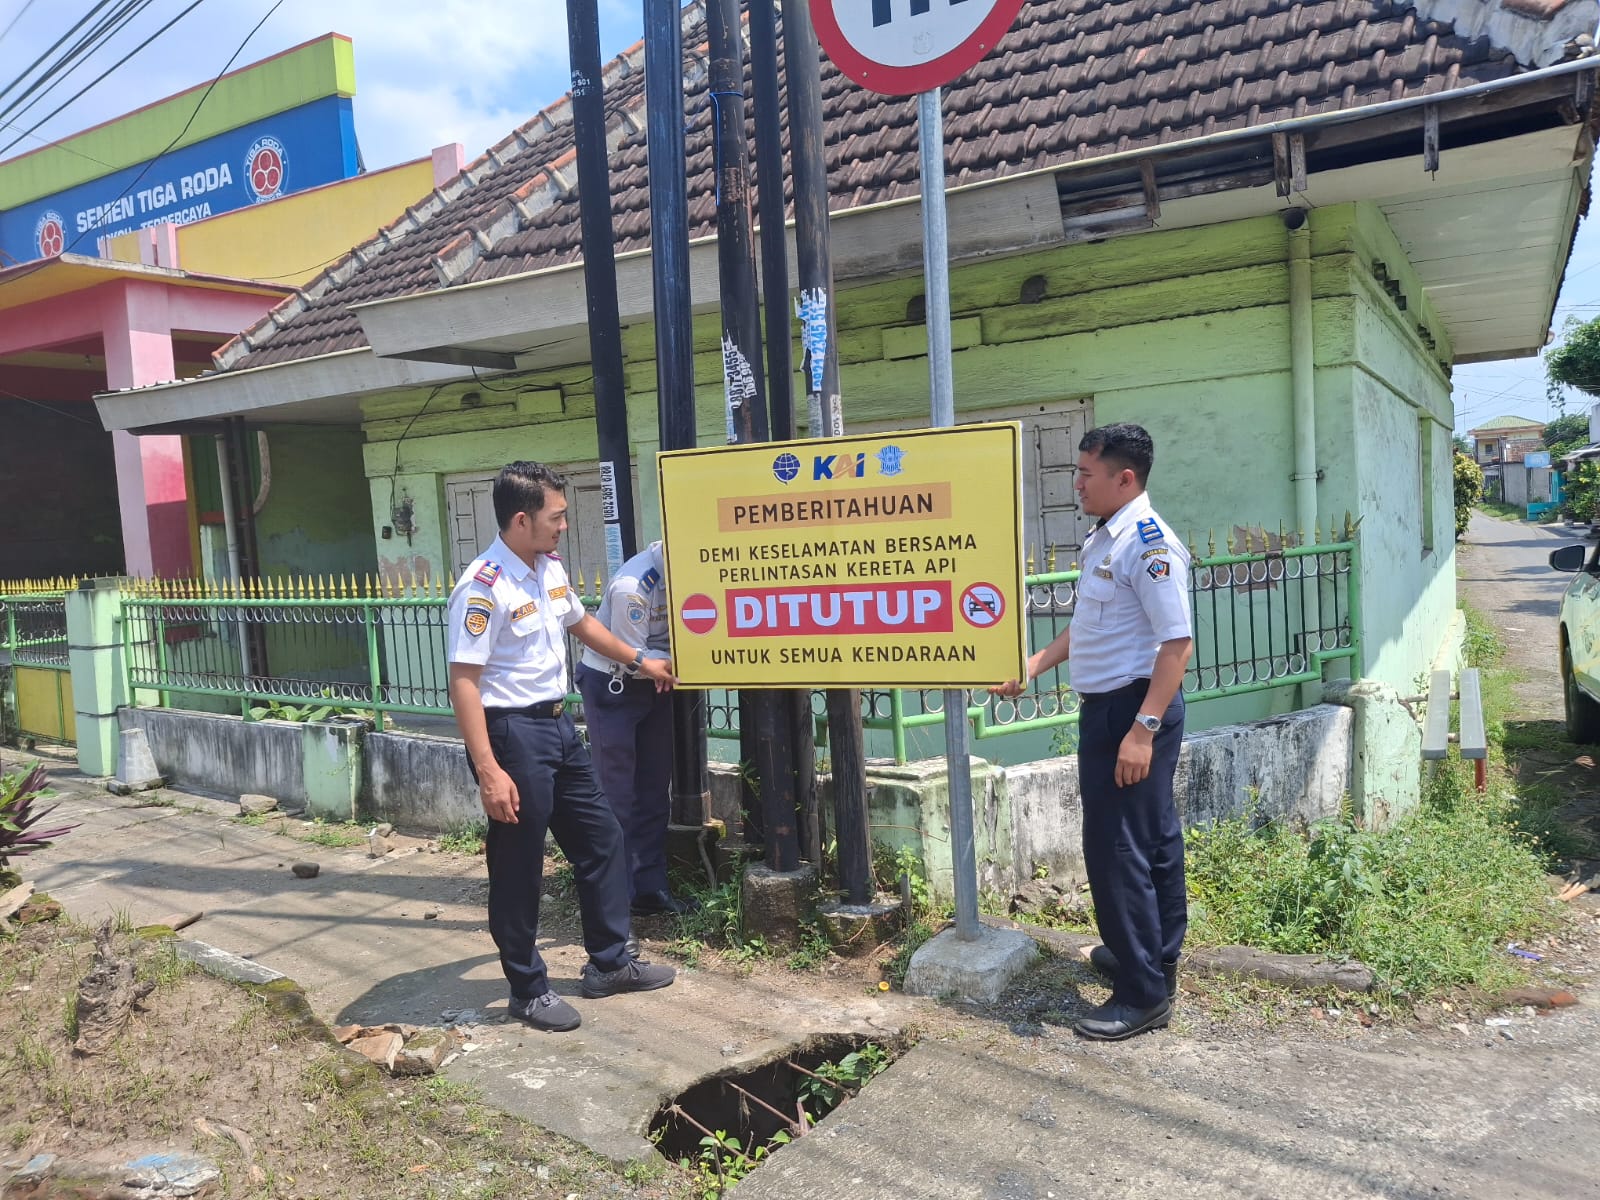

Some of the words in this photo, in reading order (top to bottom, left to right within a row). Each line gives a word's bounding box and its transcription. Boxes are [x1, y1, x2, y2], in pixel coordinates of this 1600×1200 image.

[76, 195, 135, 233] SEMEN
[137, 182, 178, 213] TIGA
[181, 163, 233, 200] RODA
[810, 325, 827, 354] 2345
[813, 452, 865, 481] KAI
[734, 492, 933, 525] PEMBERITAHUAN
[700, 546, 740, 563] DEMI
[750, 539, 875, 560] KESELAMATAN
[886, 534, 977, 553] BERSAMA
[719, 563, 837, 582] PERLINTASAN
[847, 560, 915, 577] KERETA
[925, 557, 956, 574] API
[734, 589, 942, 629] DITUTUP
[712, 649, 771, 664] UNTUK
[780, 647, 843, 663] SEMUA
[853, 645, 976, 662] KENDARAAN
